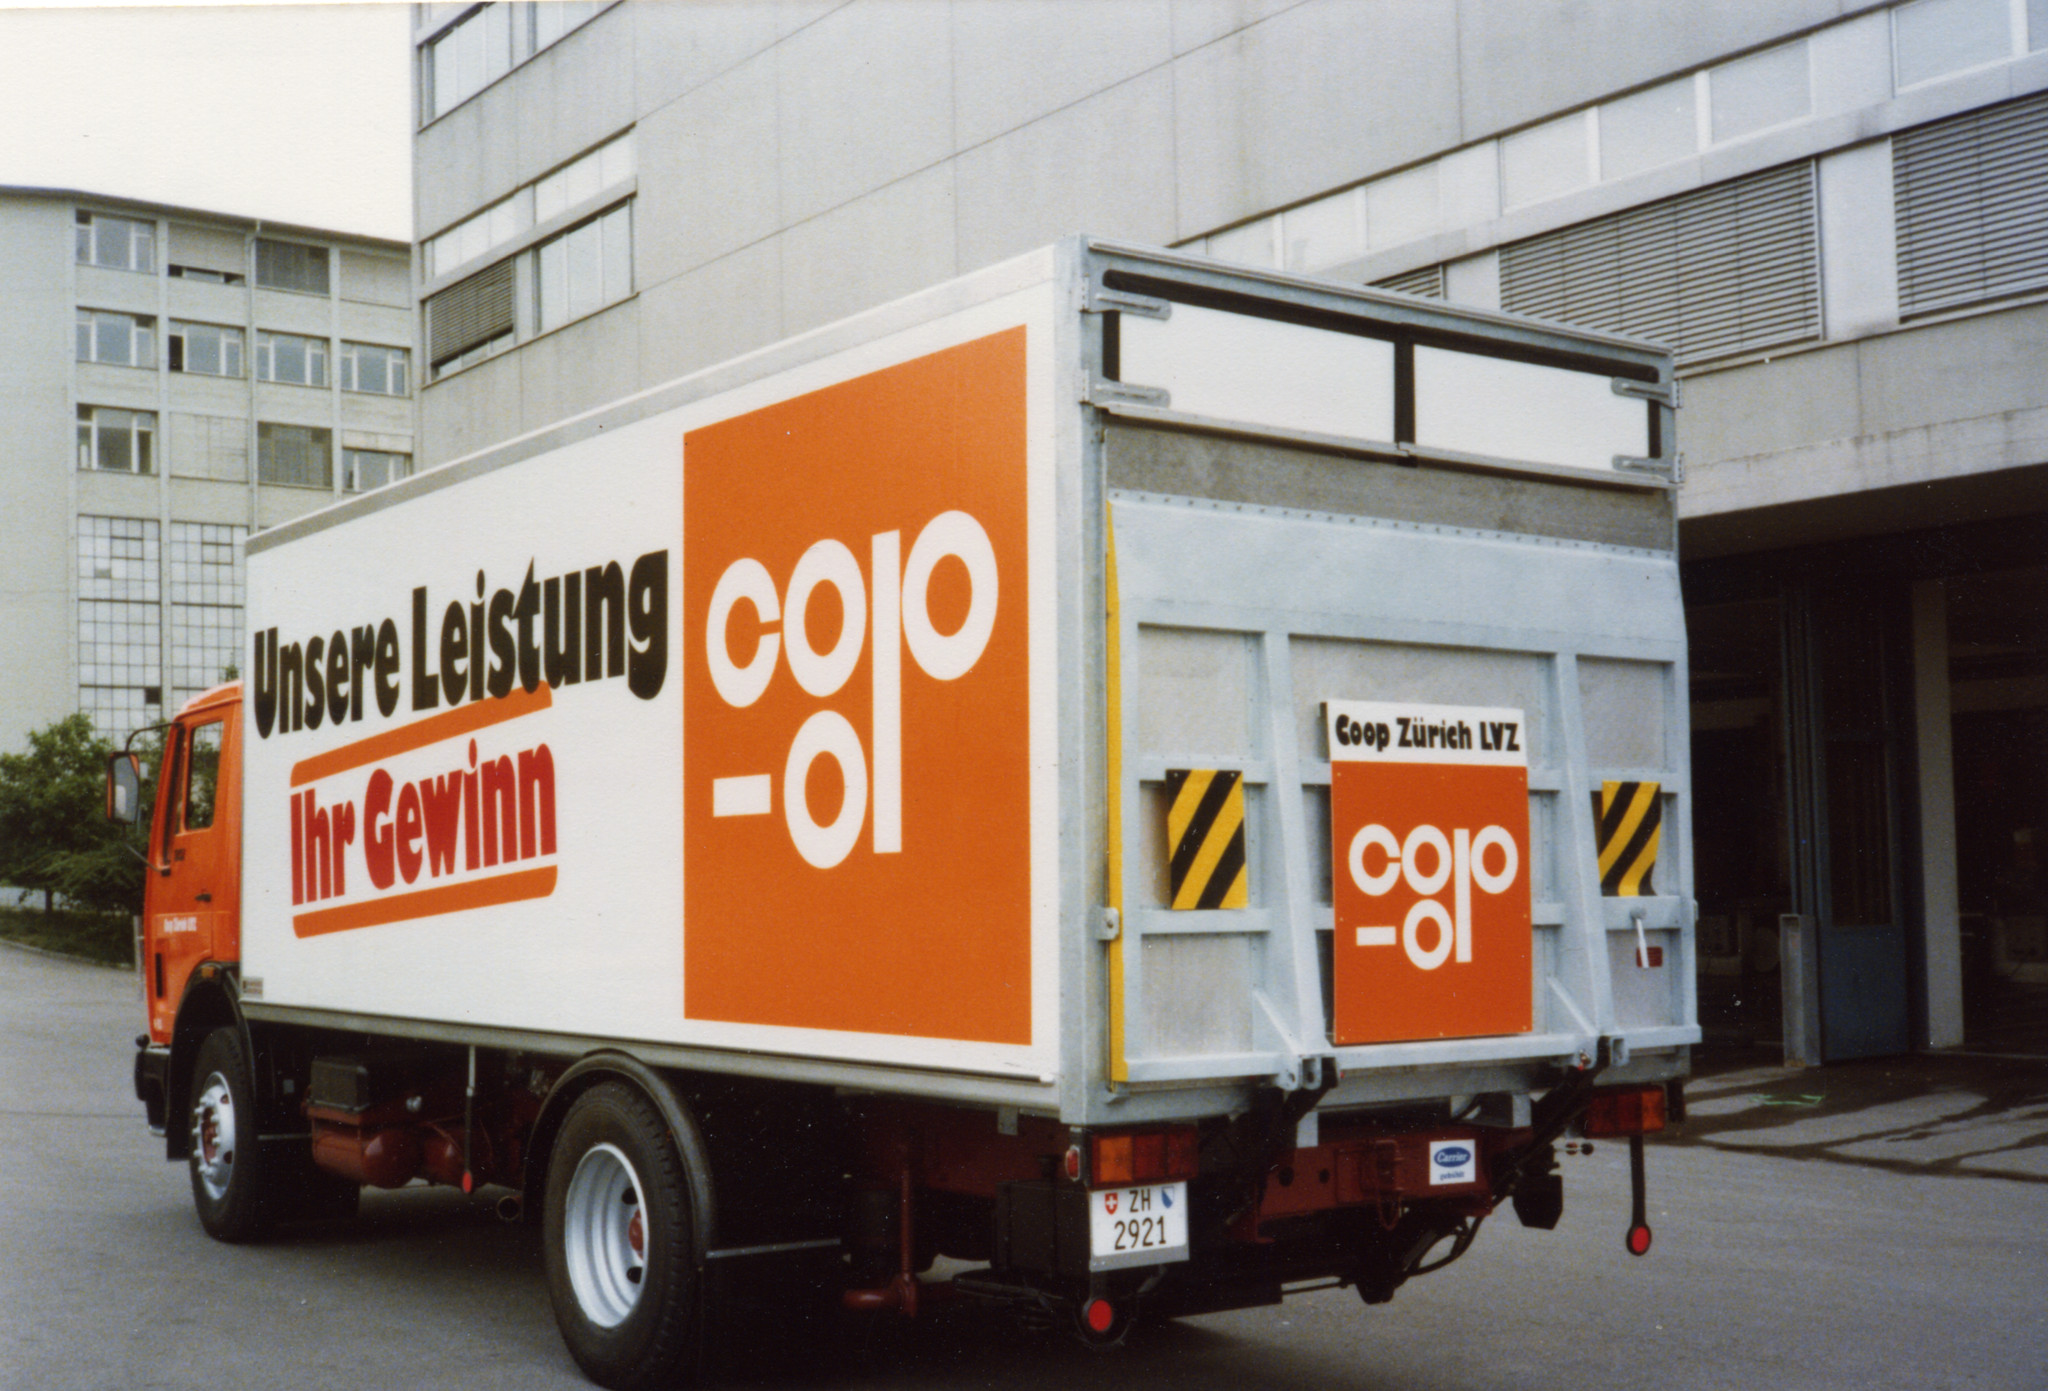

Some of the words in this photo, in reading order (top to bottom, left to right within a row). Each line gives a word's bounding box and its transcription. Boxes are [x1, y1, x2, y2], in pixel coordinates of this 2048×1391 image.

[254, 618, 400, 739] Unsere
[412, 549, 669, 701] Leistung
[1335, 714, 1390, 752] Coop
[1396, 717, 1473, 750] Zürich
[1480, 721, 1520, 752] LVZ
[290, 788, 355, 906] Ihr
[363, 738, 557, 890] Gewinn
[1129, 1188, 1151, 1213] ZH
[1114, 1216, 1167, 1250] 2921
